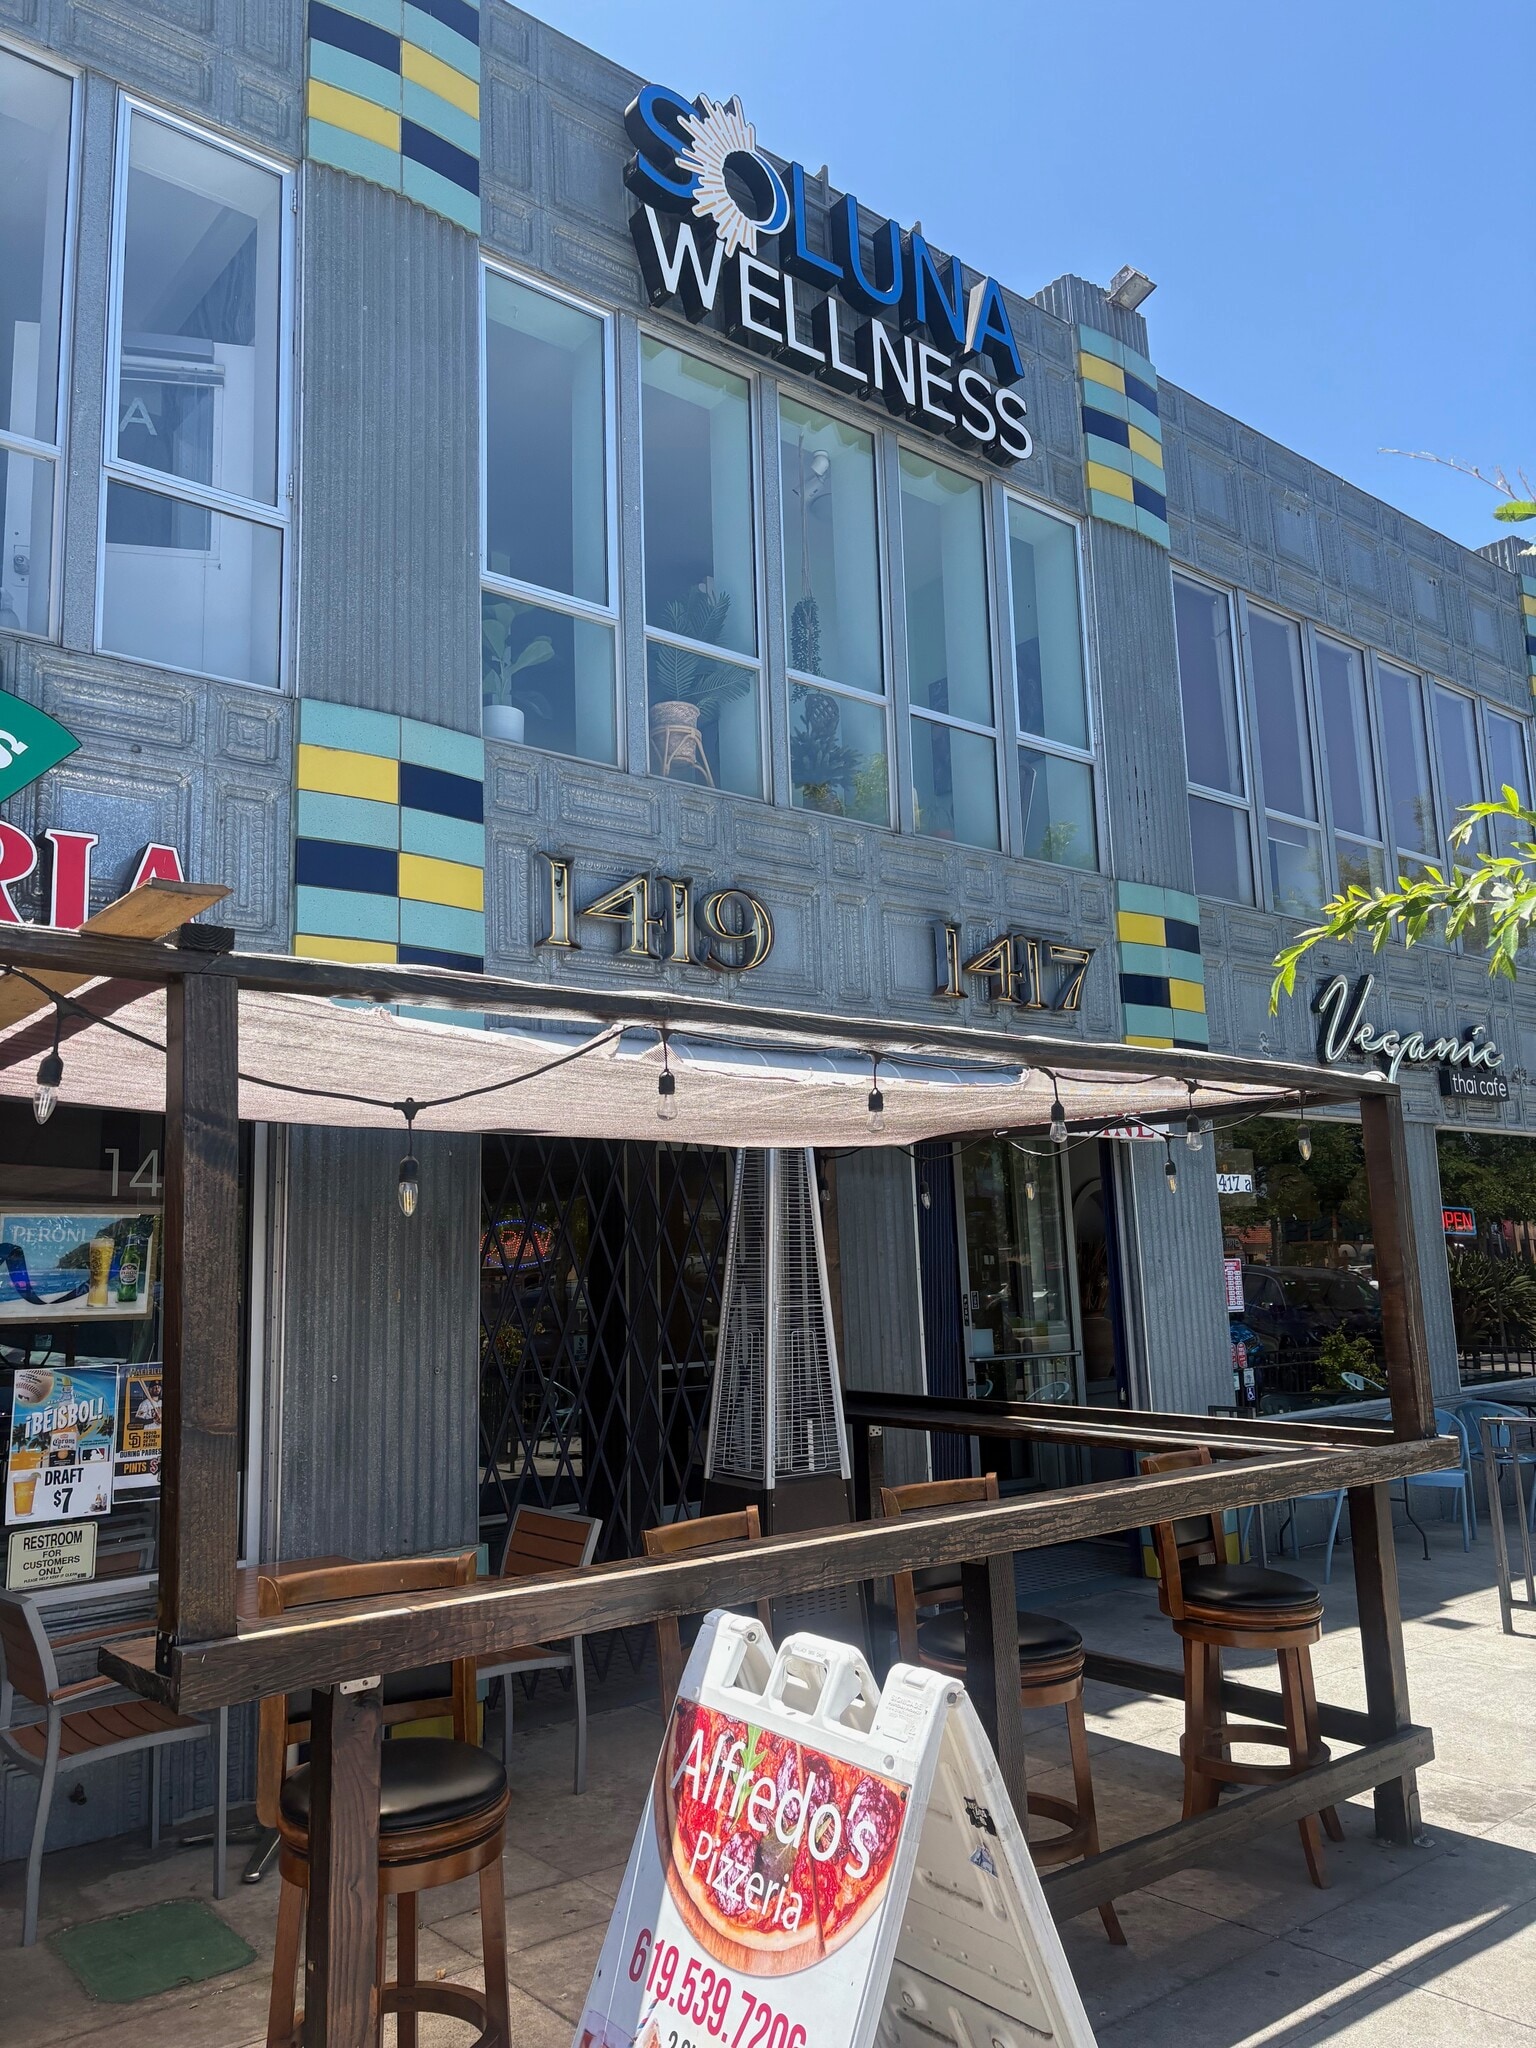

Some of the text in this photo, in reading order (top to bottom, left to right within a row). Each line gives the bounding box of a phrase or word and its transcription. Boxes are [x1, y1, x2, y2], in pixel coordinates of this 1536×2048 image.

[640, 202, 1034, 462] WELLNESS
[535, 851, 776, 973] 1419
[931, 918, 1096, 1011] 1417
[1315, 973, 1505, 1084] Veganic
[1452, 1073, 1507, 1098] thai cafe
[1442, 1211, 1473, 1231] PEN
[12, 1225, 86, 1243] PERONI
[25, 1397, 104, 1439] ¡BÉISBOL!
[44, 1467, 84, 1486] DRAFT
[123, 1462, 147, 1474] PINTS
[53, 1487, 74, 1514] $7
[23, 1530, 83, 1550] RESTROOM
[22, 1555, 81, 1570] CUSTOMERS
[42, 1549, 62, 1558] FOR
[38, 1566, 64, 1577] ONLY
[671, 1728, 878, 1881] Alfredo's
[689, 1830, 803, 1934] Pizzeria
